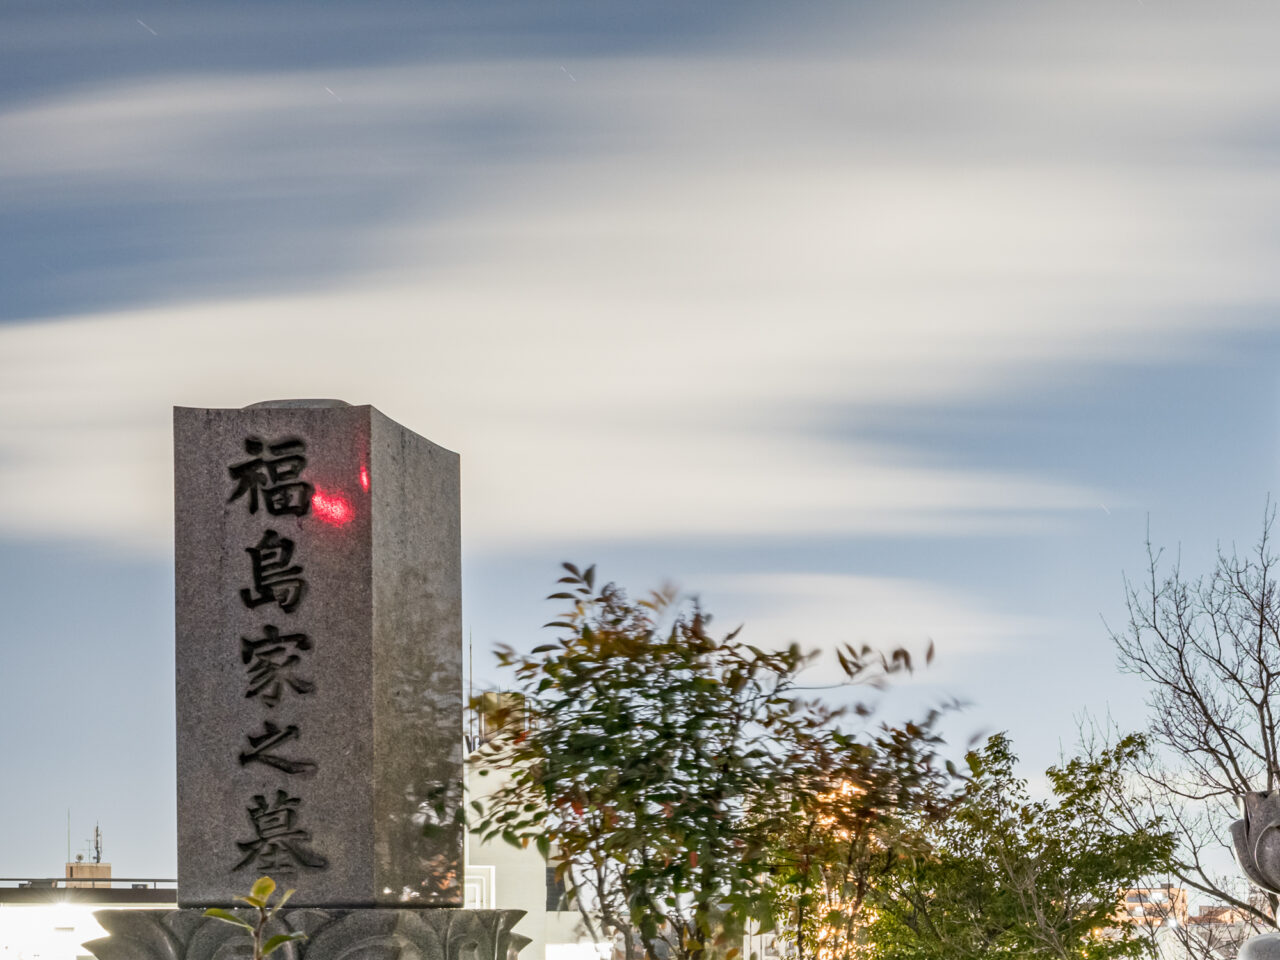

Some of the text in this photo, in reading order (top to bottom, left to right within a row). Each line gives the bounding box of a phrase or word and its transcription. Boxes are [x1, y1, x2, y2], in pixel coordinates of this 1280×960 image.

[227, 435, 328, 876] 福島家之墓
